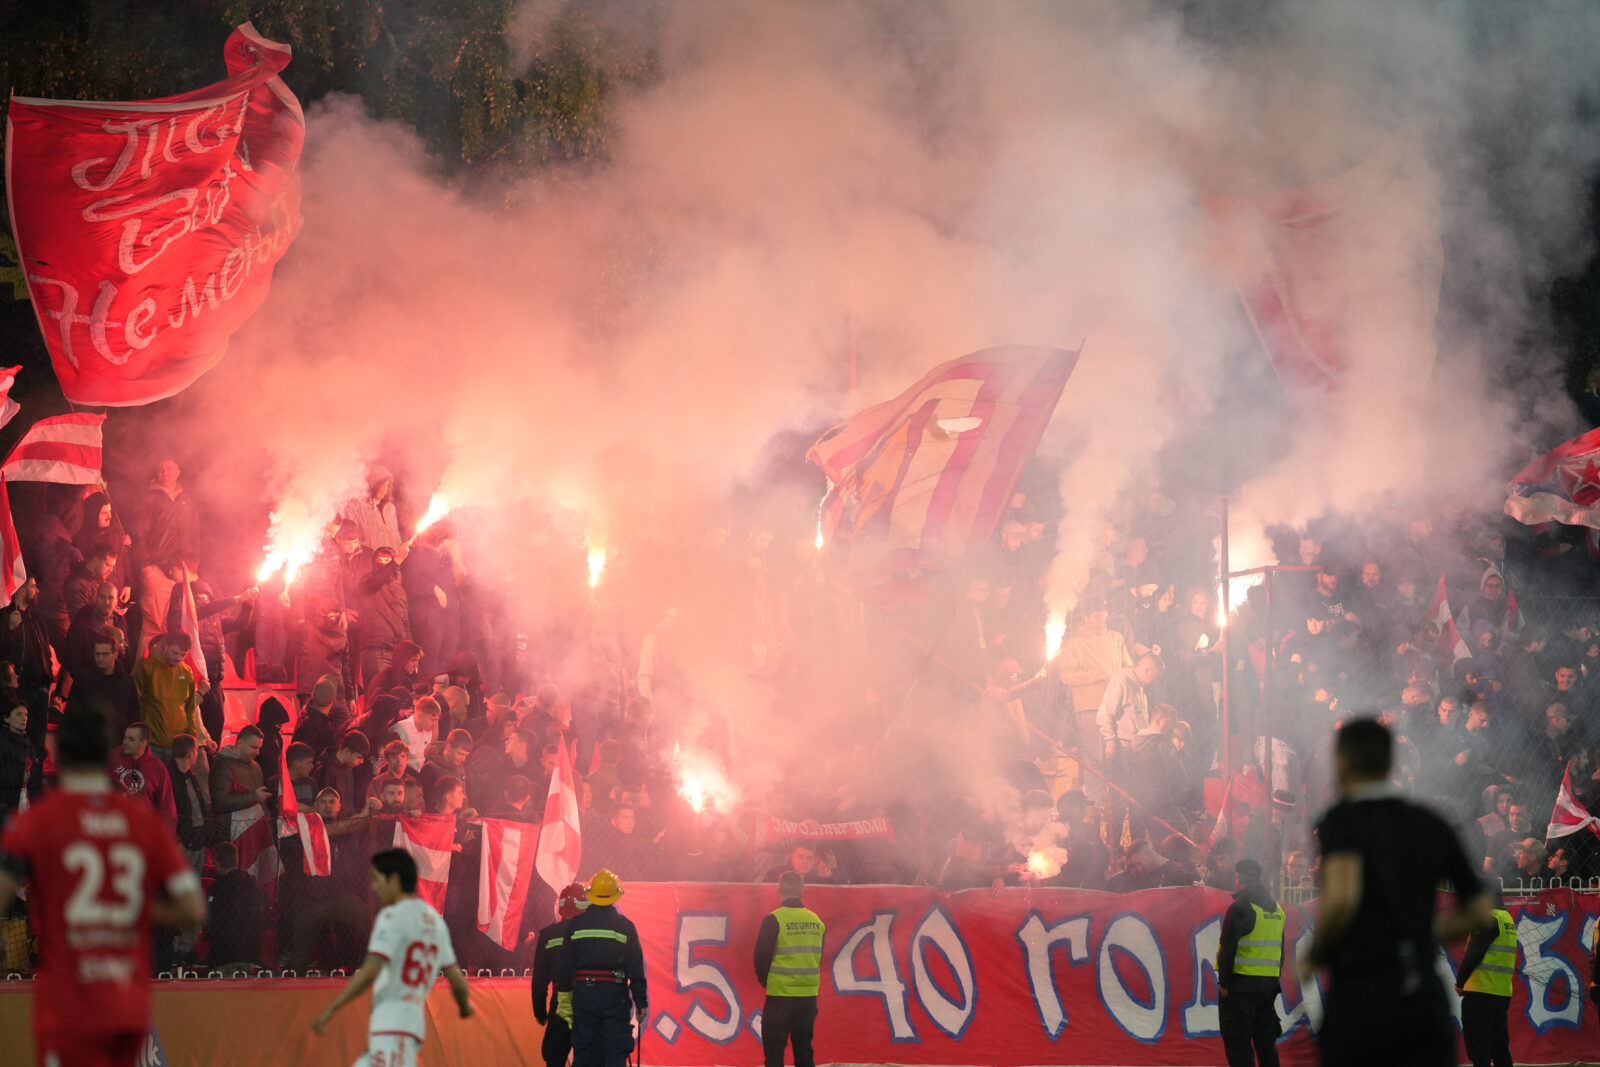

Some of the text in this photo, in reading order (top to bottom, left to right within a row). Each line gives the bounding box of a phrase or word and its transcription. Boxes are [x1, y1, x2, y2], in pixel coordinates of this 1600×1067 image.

[63, 843, 148, 928] 23
[786, 921, 821, 931] SECURITY
[831, 902, 979, 1043] 40
